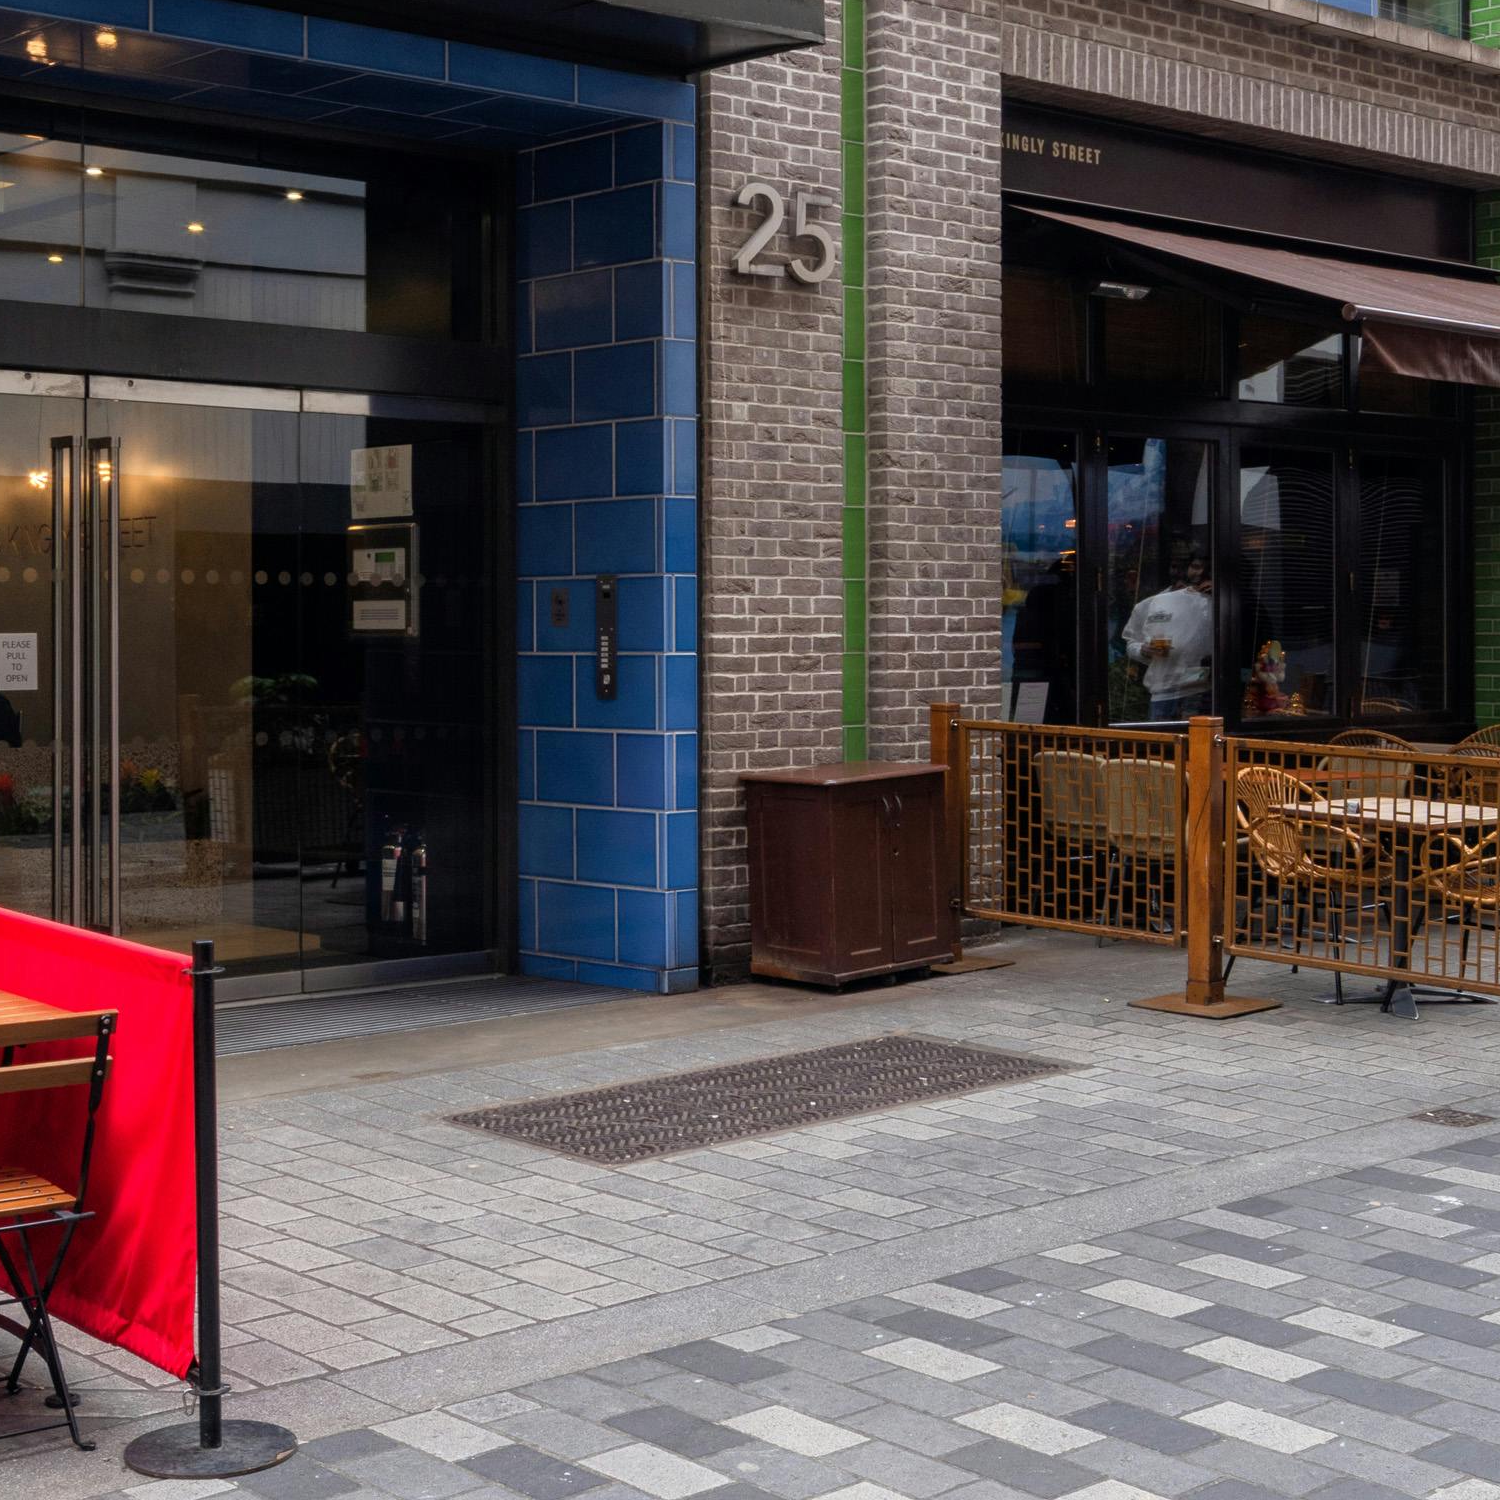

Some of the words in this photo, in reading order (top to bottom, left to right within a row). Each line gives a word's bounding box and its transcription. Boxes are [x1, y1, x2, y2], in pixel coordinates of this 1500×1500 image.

[1052, 141, 1101, 165] STREET
[731, 182, 836, 283] 25
[2, 640, 32, 649] PLEASE
[6, 652, 28, 660] PULL
[11, 662, 23, 671] TO
[5, 674, 29, 683] OPEN
